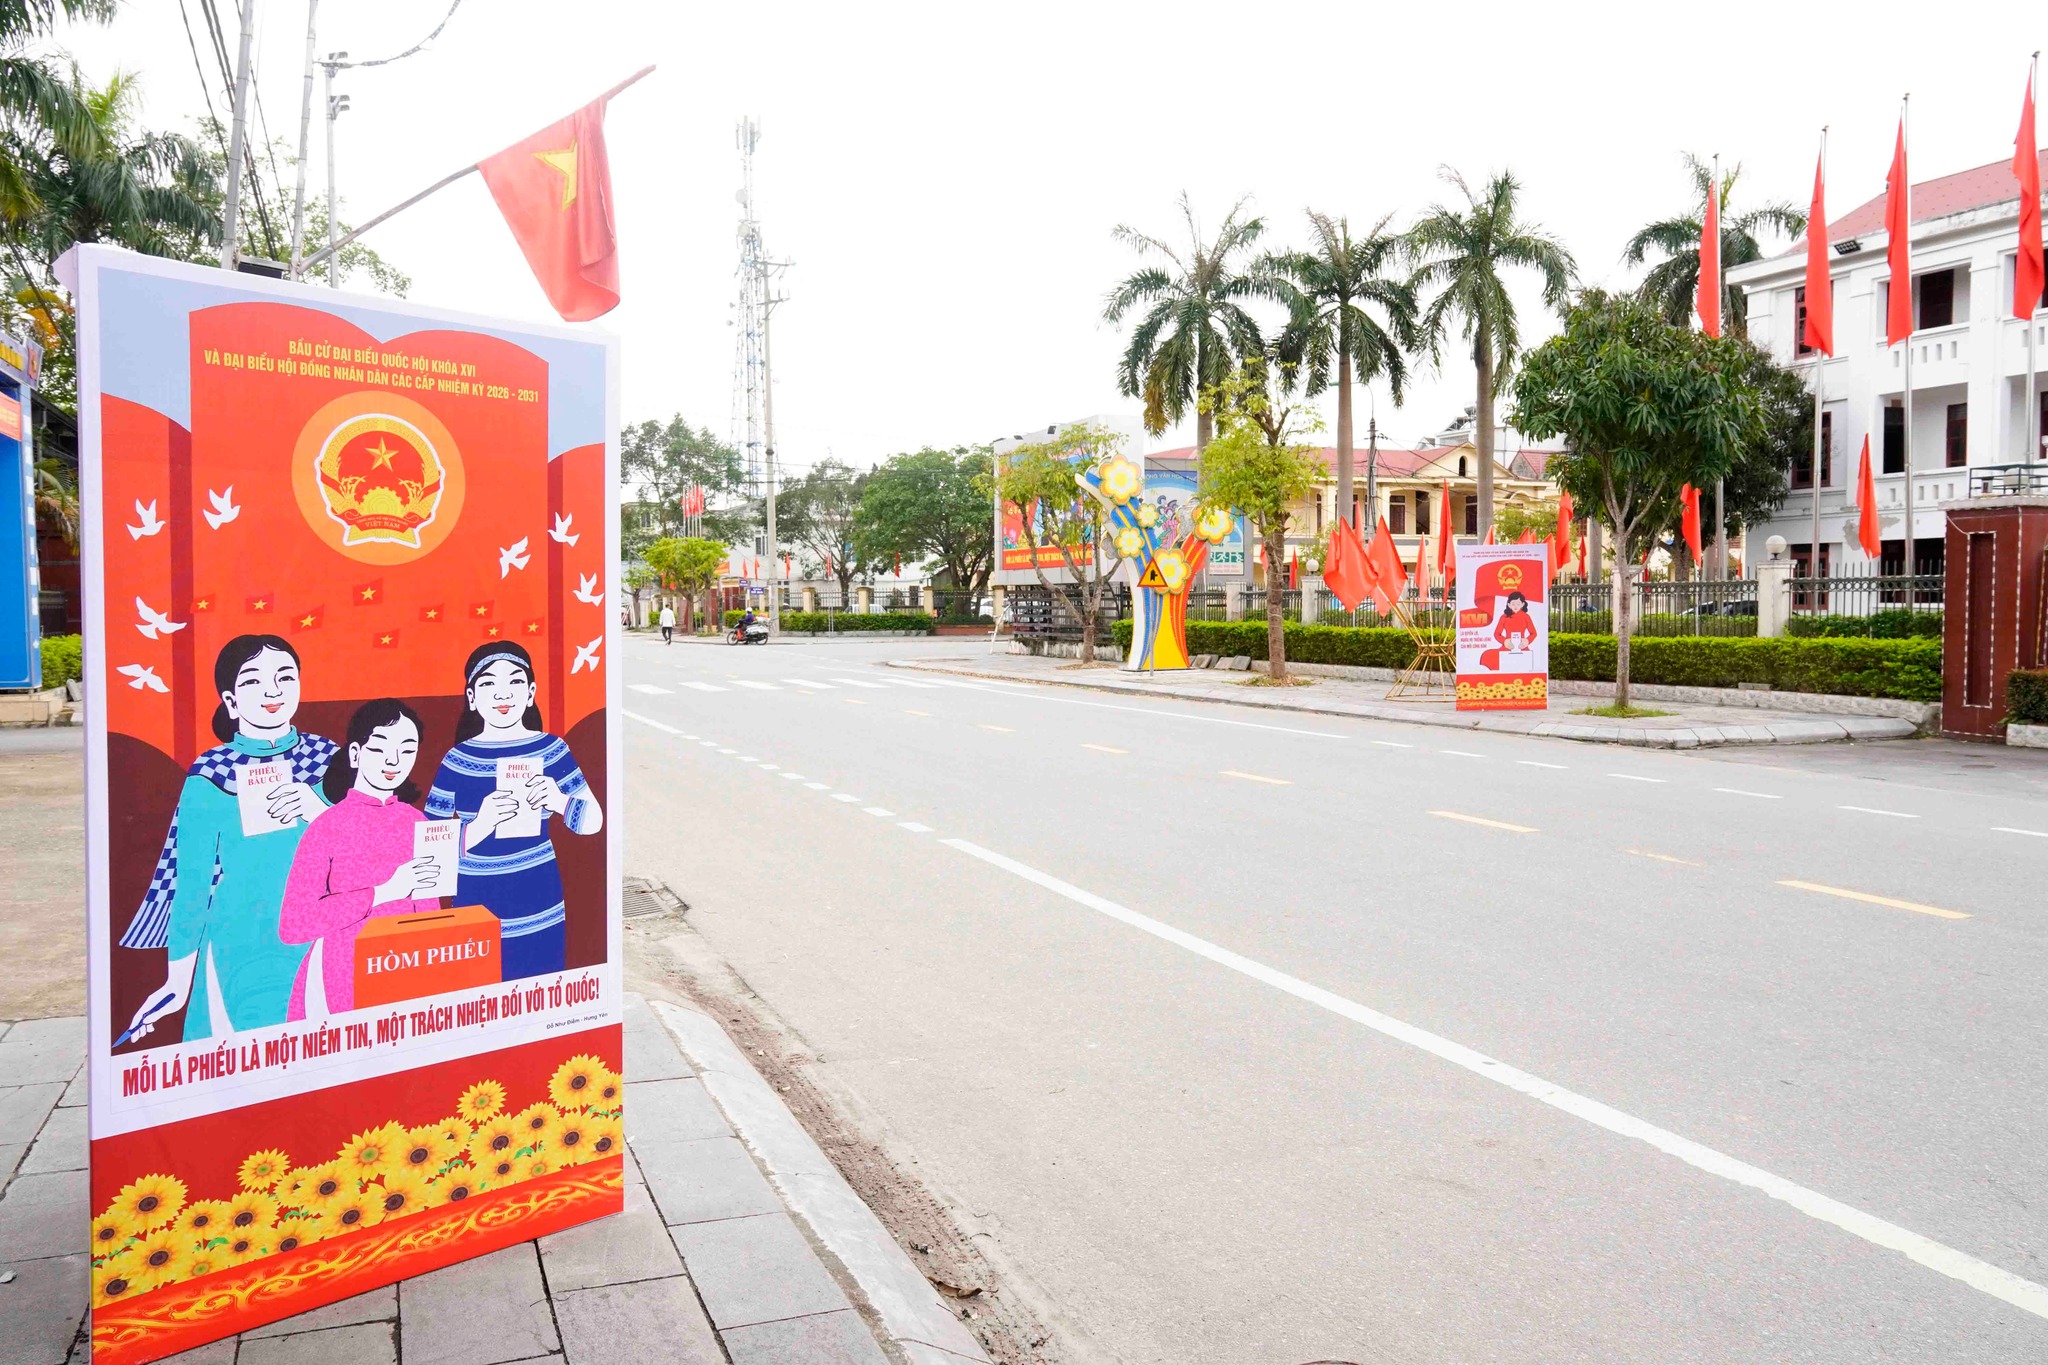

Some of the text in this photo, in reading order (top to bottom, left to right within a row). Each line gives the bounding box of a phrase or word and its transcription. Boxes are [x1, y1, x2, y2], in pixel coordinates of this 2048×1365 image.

[204, 348, 221, 366] VÀ
[223, 352, 244, 370] ĐẠI
[247, 351, 274, 372] BIỂU
[277, 358, 297, 377] HỘI
[300, 358, 331, 379] ĐỒNG
[333, 365, 364, 383] NHÂN
[367, 368, 389, 385] DÂN
[391, 372, 412, 388] CÁC
[415, 373, 435, 391] CẤP
[437, 379, 470, 396] NHIỆM
[472, 381, 484, 397] KỲ
[486, 385, 509, 399] 2026
[518, 389, 539, 403] 2031
[289, 337, 476, 378] BẦU CỬ ĐẠI BIỂU QUỐC HỘI KHÓA XVI
[1460, 613, 1488, 625] XVI
[366, 937, 491, 975] HÒM PHIẾU
[123, 971, 600, 1097] MỖI LÁ PHIẾU LÀ MỘT NIỀM TIN, MỘT TRÁCH NHIỆM ĐỐI VỚI TỔ QUỐC!
